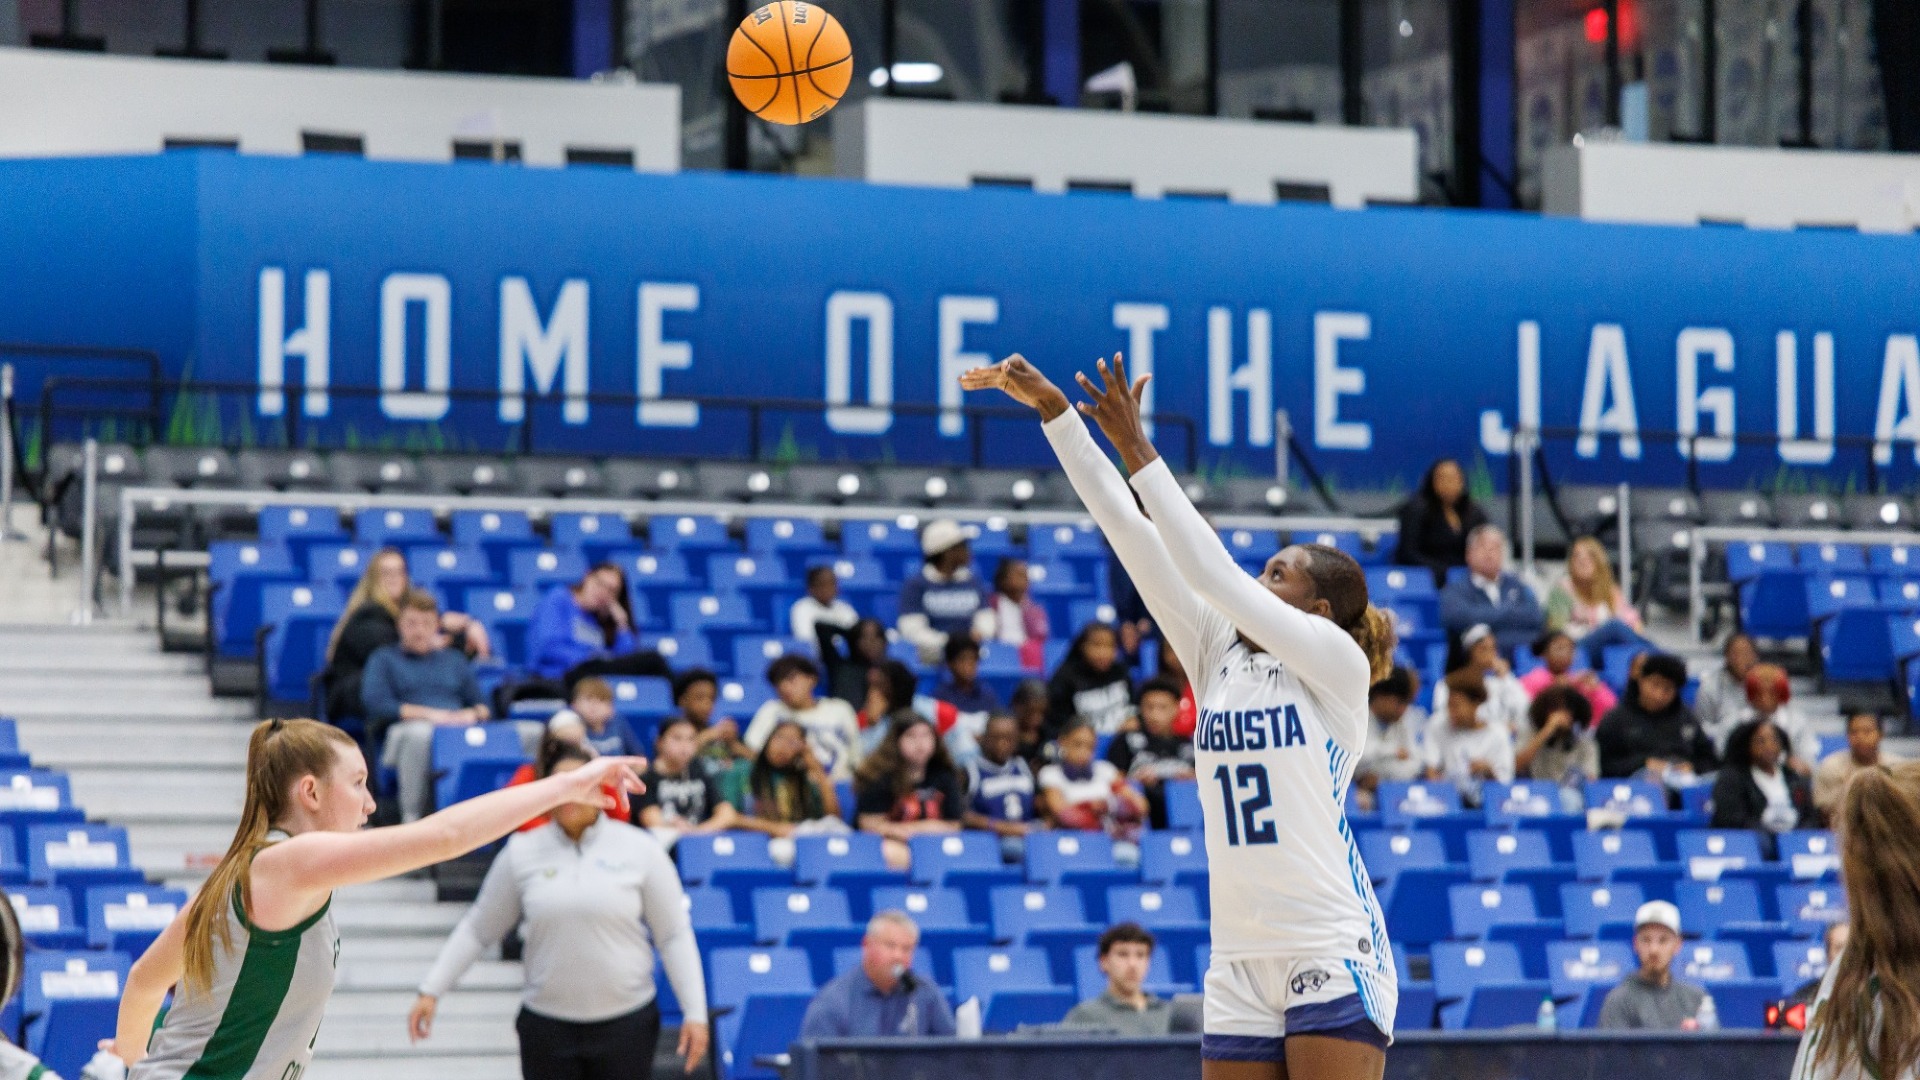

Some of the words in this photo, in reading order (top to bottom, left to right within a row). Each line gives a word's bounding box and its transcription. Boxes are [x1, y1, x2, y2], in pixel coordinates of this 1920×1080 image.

[258, 267, 701, 427] HOME
[825, 290, 999, 436] OF
[1112, 302, 1373, 449] THE
[1479, 320, 1920, 465] JAGUA
[1213, 763, 1278, 846] 12
